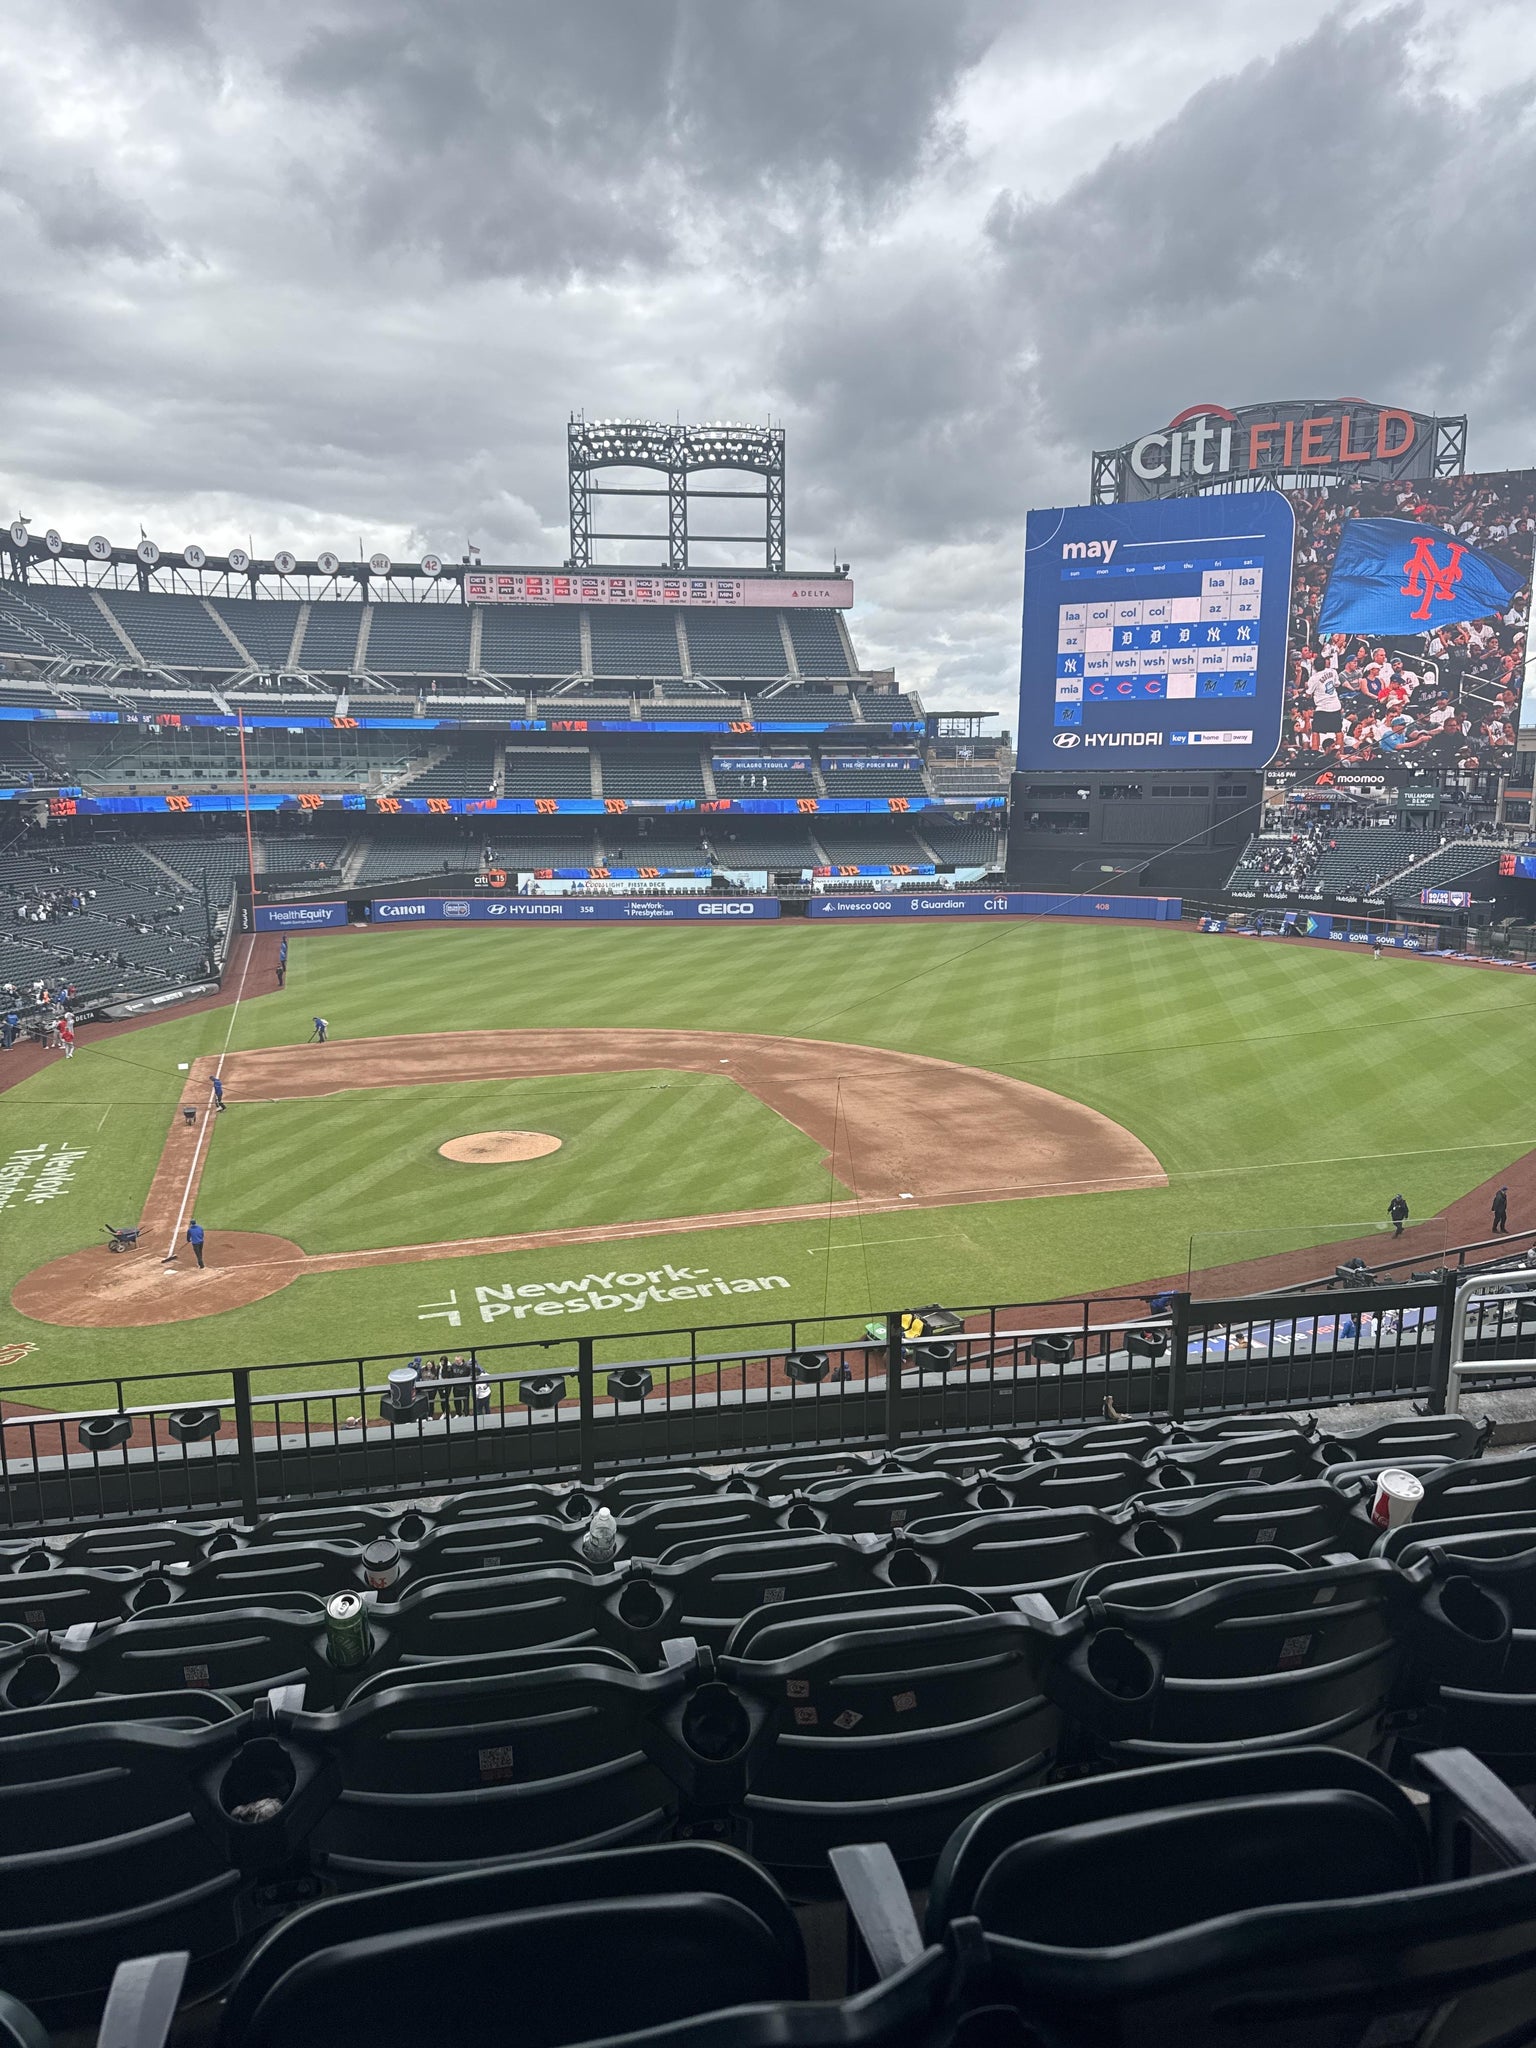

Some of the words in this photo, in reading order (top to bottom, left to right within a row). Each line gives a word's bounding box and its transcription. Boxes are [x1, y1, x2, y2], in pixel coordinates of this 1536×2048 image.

[1250, 410, 1415, 470] FIELD
[15, 528, 23, 540] 17
[49, 535, 59, 547] 36
[95, 541, 105, 553] 31
[143, 546, 154, 558] 41
[1062, 539, 1118, 564] may
[190, 551, 200, 562] 14
[233, 555, 245, 565] 37
[425, 561, 438, 571] 42
[1209, 577, 1225, 588] laa
[1239, 576, 1255, 586] laa
[1121, 607, 1136, 617] col
[1149, 605, 1165, 616] col
[1209, 605, 1222, 613] az
[1239, 603, 1252, 612] az
[1066, 611, 1081, 621] laa
[1093, 609, 1108, 619] col
[1066, 637, 1078, 645] az
[1088, 658, 1109, 668] wsh
[1115, 657, 1136, 667] wsh
[1143, 655, 1165, 666] wsh
[1172, 655, 1194, 665] wsh
[1202, 654, 1223, 664] mia
[1232, 653, 1253, 663] mia
[1060, 684, 1079, 694] mia
[126, 714, 138, 722] 3:46
[1085, 732, 1163, 746] HYUNDAI
[1172, 734, 1186, 743] key
[1337, 775, 1384, 783] moomoo
[474, 876, 488, 884] citi
[698, 903, 753, 914] GEICO
[837, 902, 872, 911] Invesco
[873, 902, 892, 911] QQQ
[921, 901, 965, 909] Guardian
[984, 898, 1008, 910] citi
[269, 908, 332, 920] HealthEquity
[379, 904, 426, 916] Canon
[510, 905, 562, 914] HYUNDAI
[631, 909, 673, 918] Presbyterian
[1329, 931, 1343, 940] 380
[1349, 933, 1369, 941] GOYA
[1376, 936, 1396, 944] GOYA
[76, 1013, 94, 1022] DELTA
[475, 1264, 710, 1303] NewYork-
[479, 1275, 791, 1323] Presbyterian
